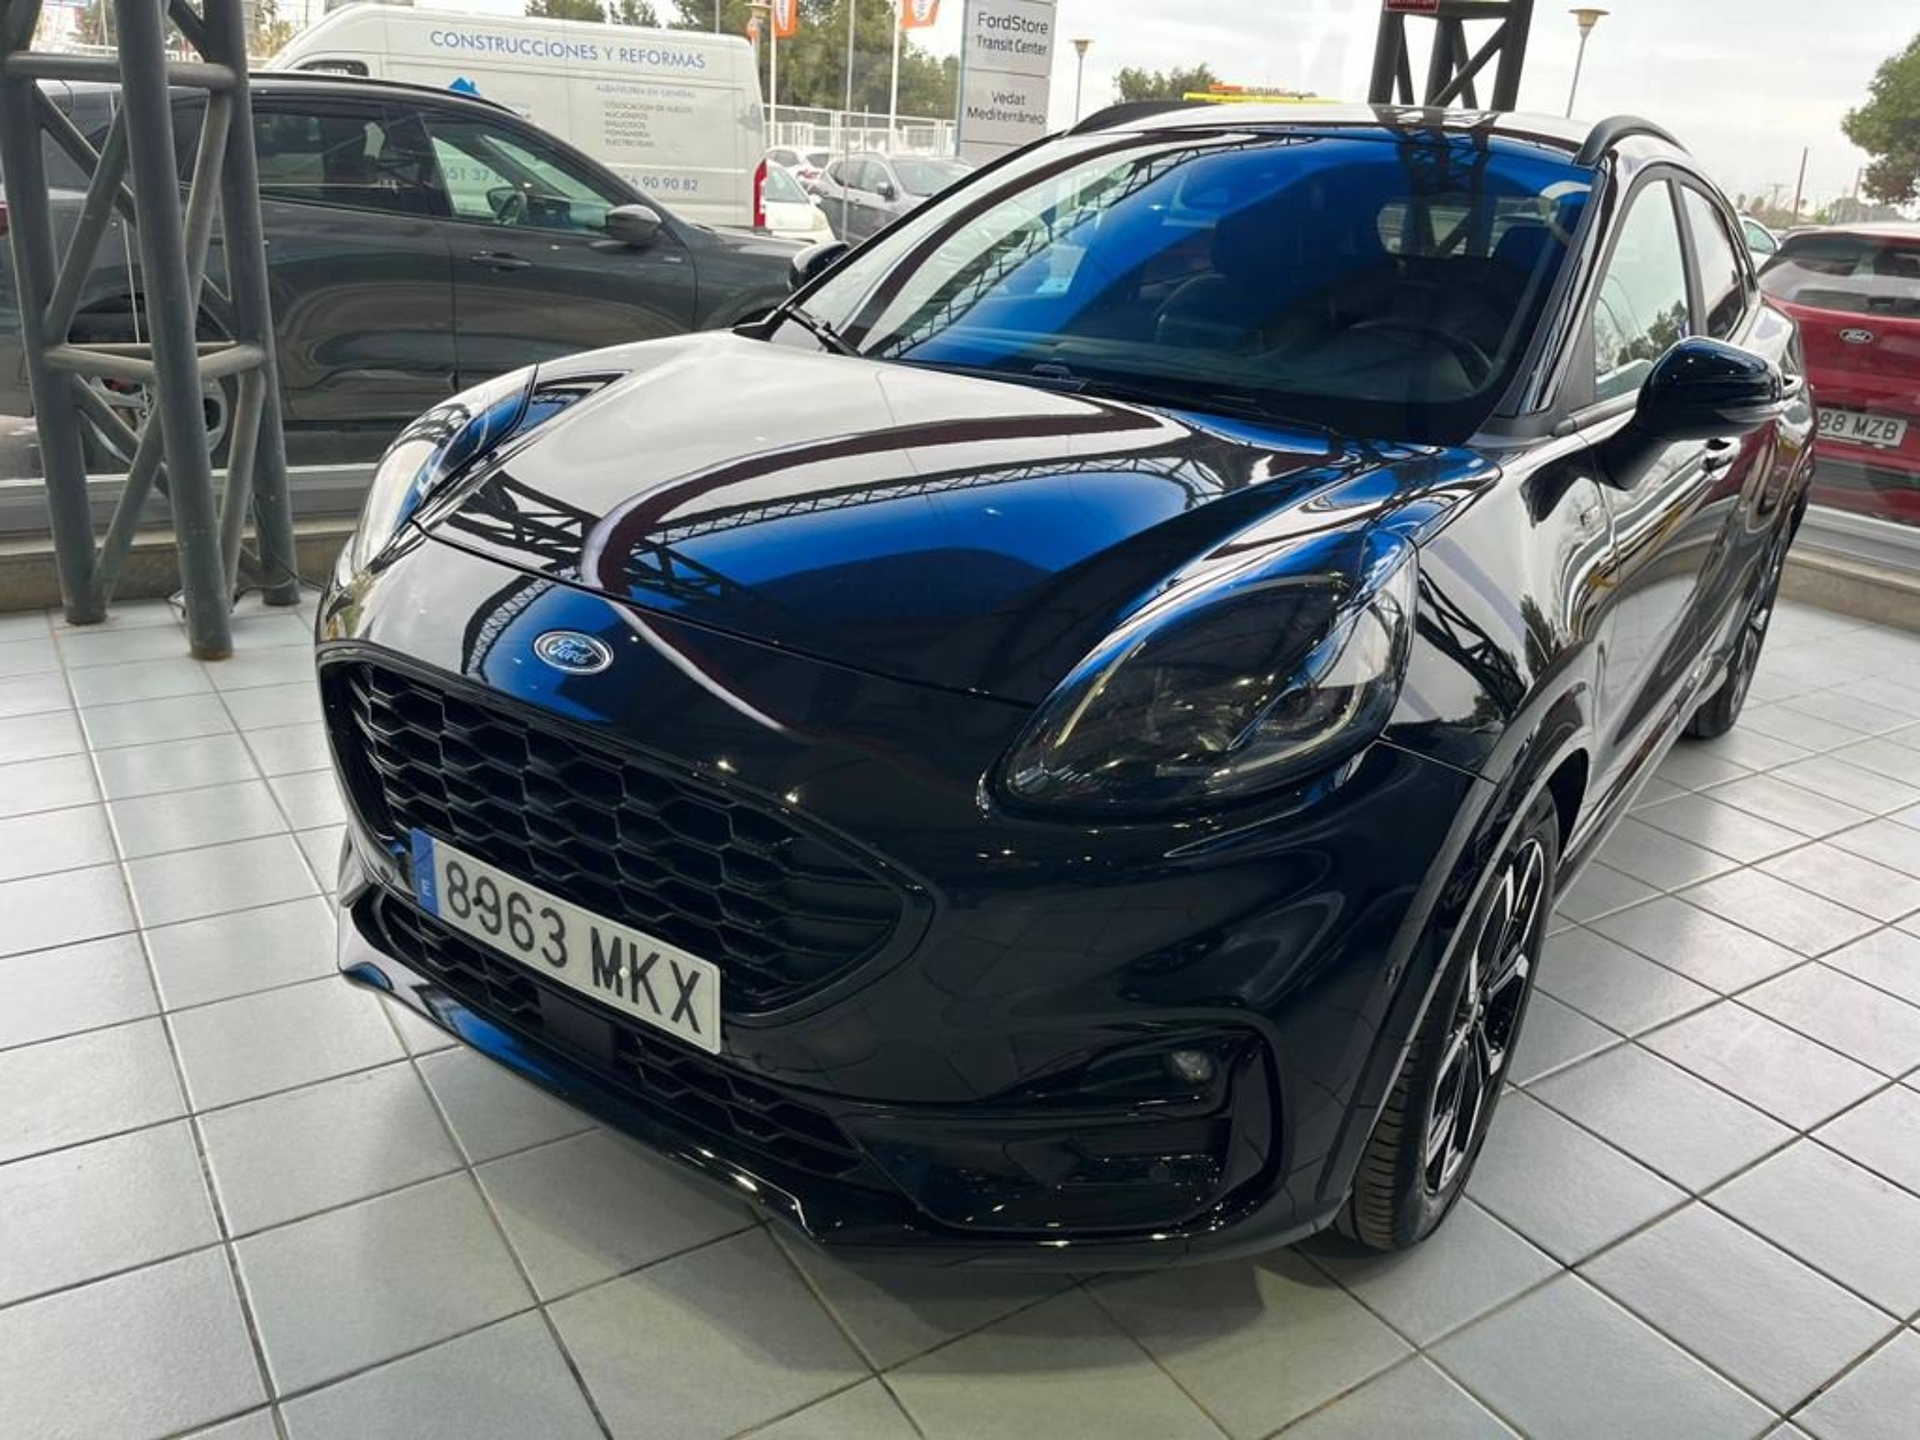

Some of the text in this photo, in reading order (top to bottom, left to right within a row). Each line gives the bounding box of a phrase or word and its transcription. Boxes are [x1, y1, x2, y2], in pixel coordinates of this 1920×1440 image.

[978, 11, 1048, 34] FordStore
[430, 31, 706, 69] CONSTRUCCIONES Y REFORMAS
[977, 35, 1047, 55] Transit Center
[991, 91, 1026, 105] Vedat
[967, 106, 1046, 125] Mediterráneo
[642, 176, 659, 189] 90
[663, 177, 680, 190] 90
[684, 179, 698, 191] 82
[1852, 415, 1898, 440] MZB
[446, 861, 701, 1034] 8963 MKX
